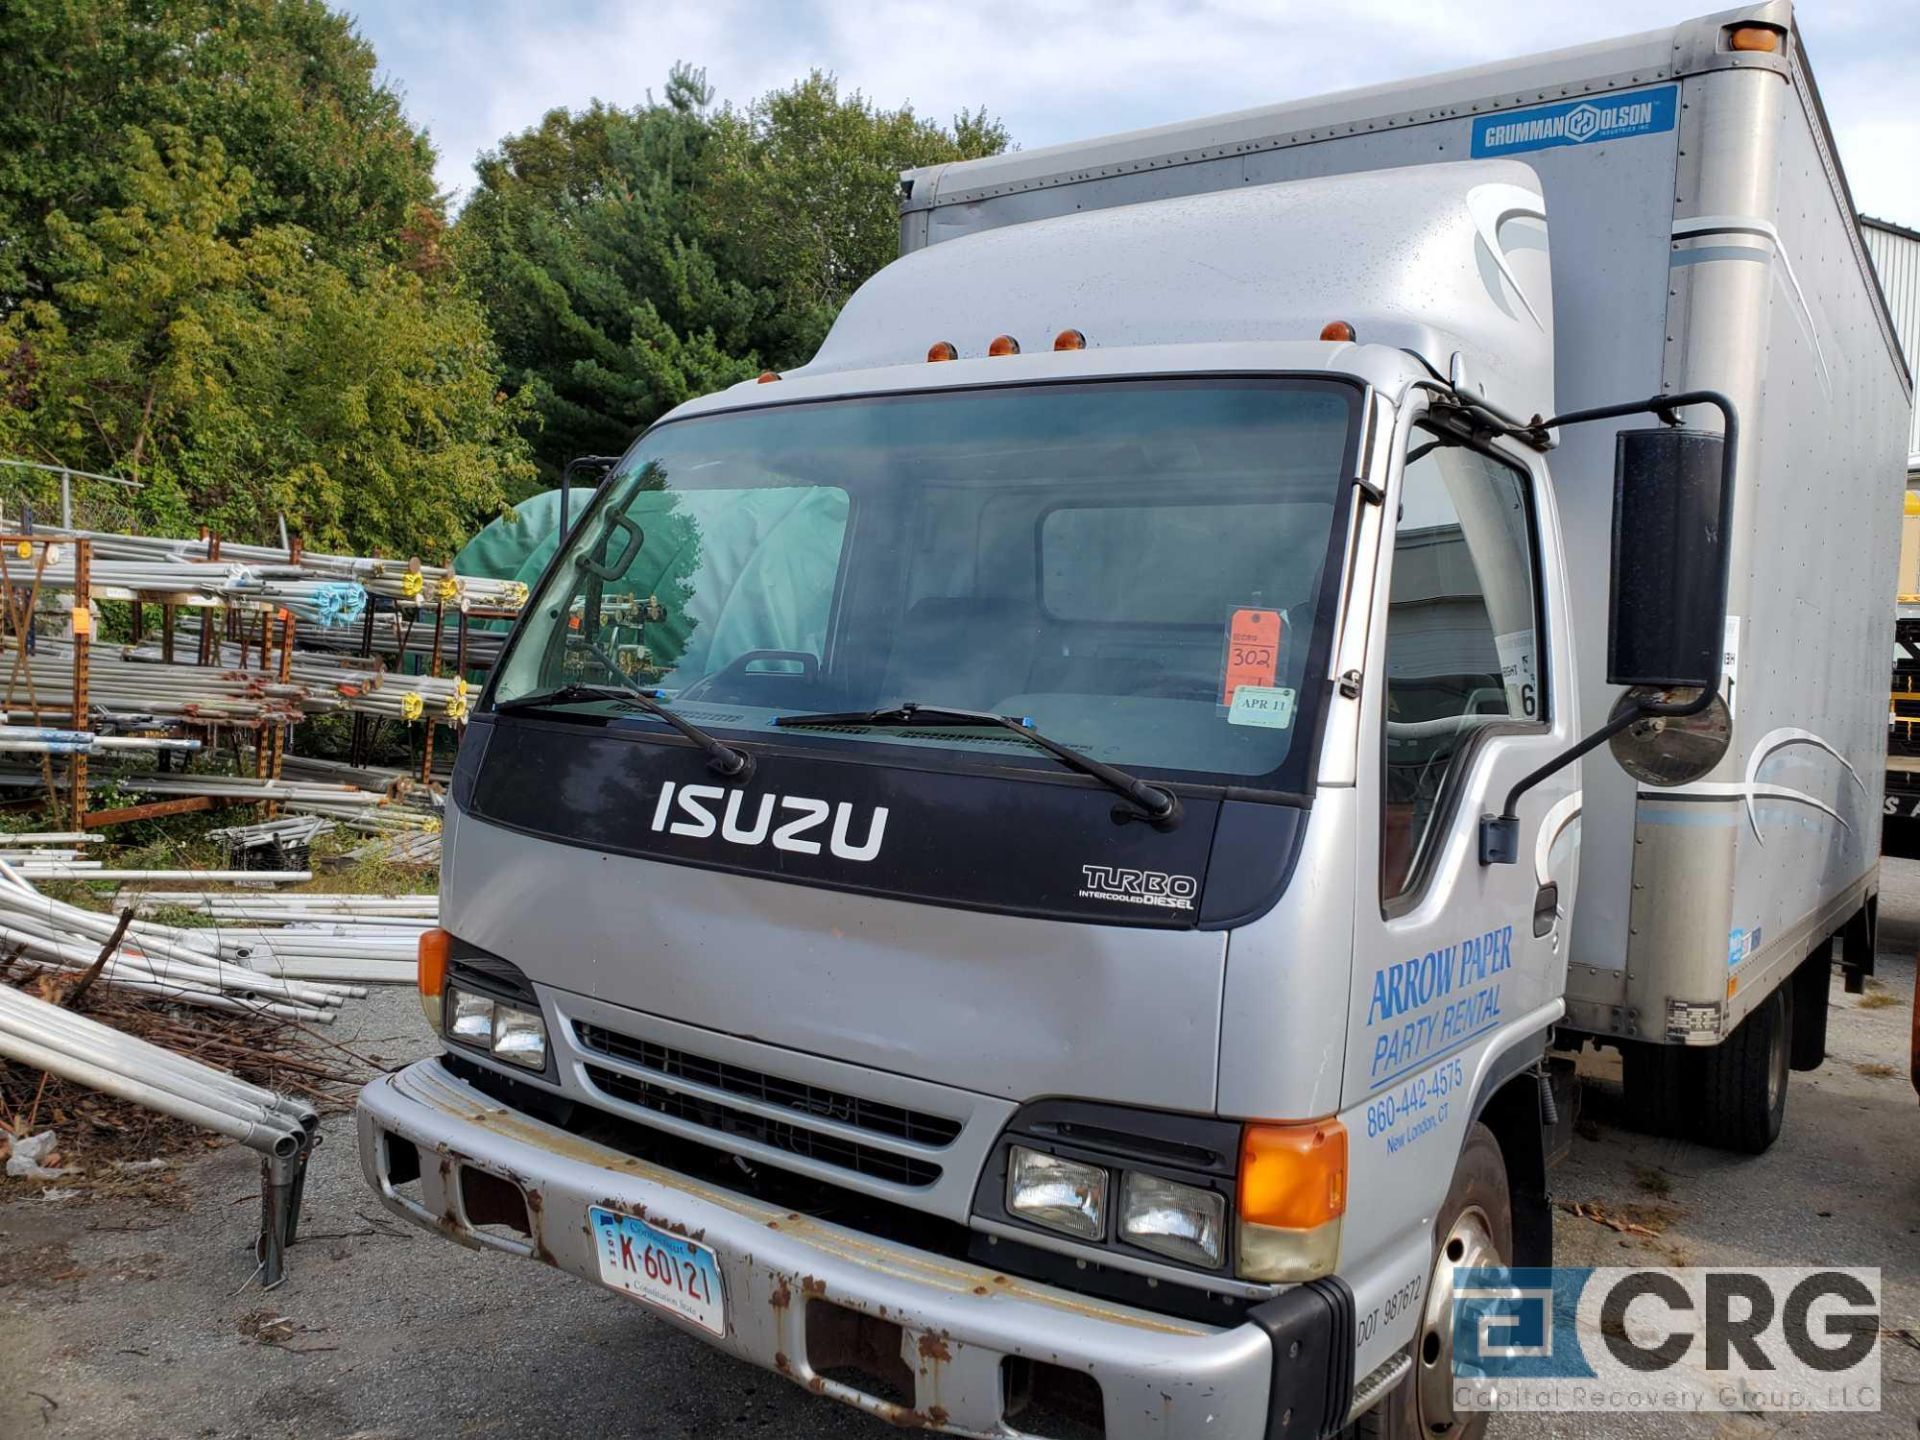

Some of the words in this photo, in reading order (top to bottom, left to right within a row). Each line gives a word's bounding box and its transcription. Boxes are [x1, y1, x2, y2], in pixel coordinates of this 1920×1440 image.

[1485, 115, 1565, 147] GRUMMAN
[1600, 102, 1652, 130] OLSON
[1234, 648, 1271, 668] 302
[1242, 698, 1268, 709] APR
[1273, 701, 1285, 711] 11
[651, 781, 889, 862] ISUZU
[1083, 864, 1197, 899] TURBO
[1366, 945, 1457, 1026] ARROW
[1459, 925, 1513, 988] PAPER
[1371, 1010, 1440, 1077] PARTY
[1440, 983, 1501, 1042] RENTAL
[1367, 1058, 1463, 1138] 860-442-4575
[1386, 1133, 1406, 1155] New
[1438, 1102, 1449, 1123] CT
[1357, 1308, 1379, 1347] DOT
[1384, 1275, 1421, 1325] 987672
